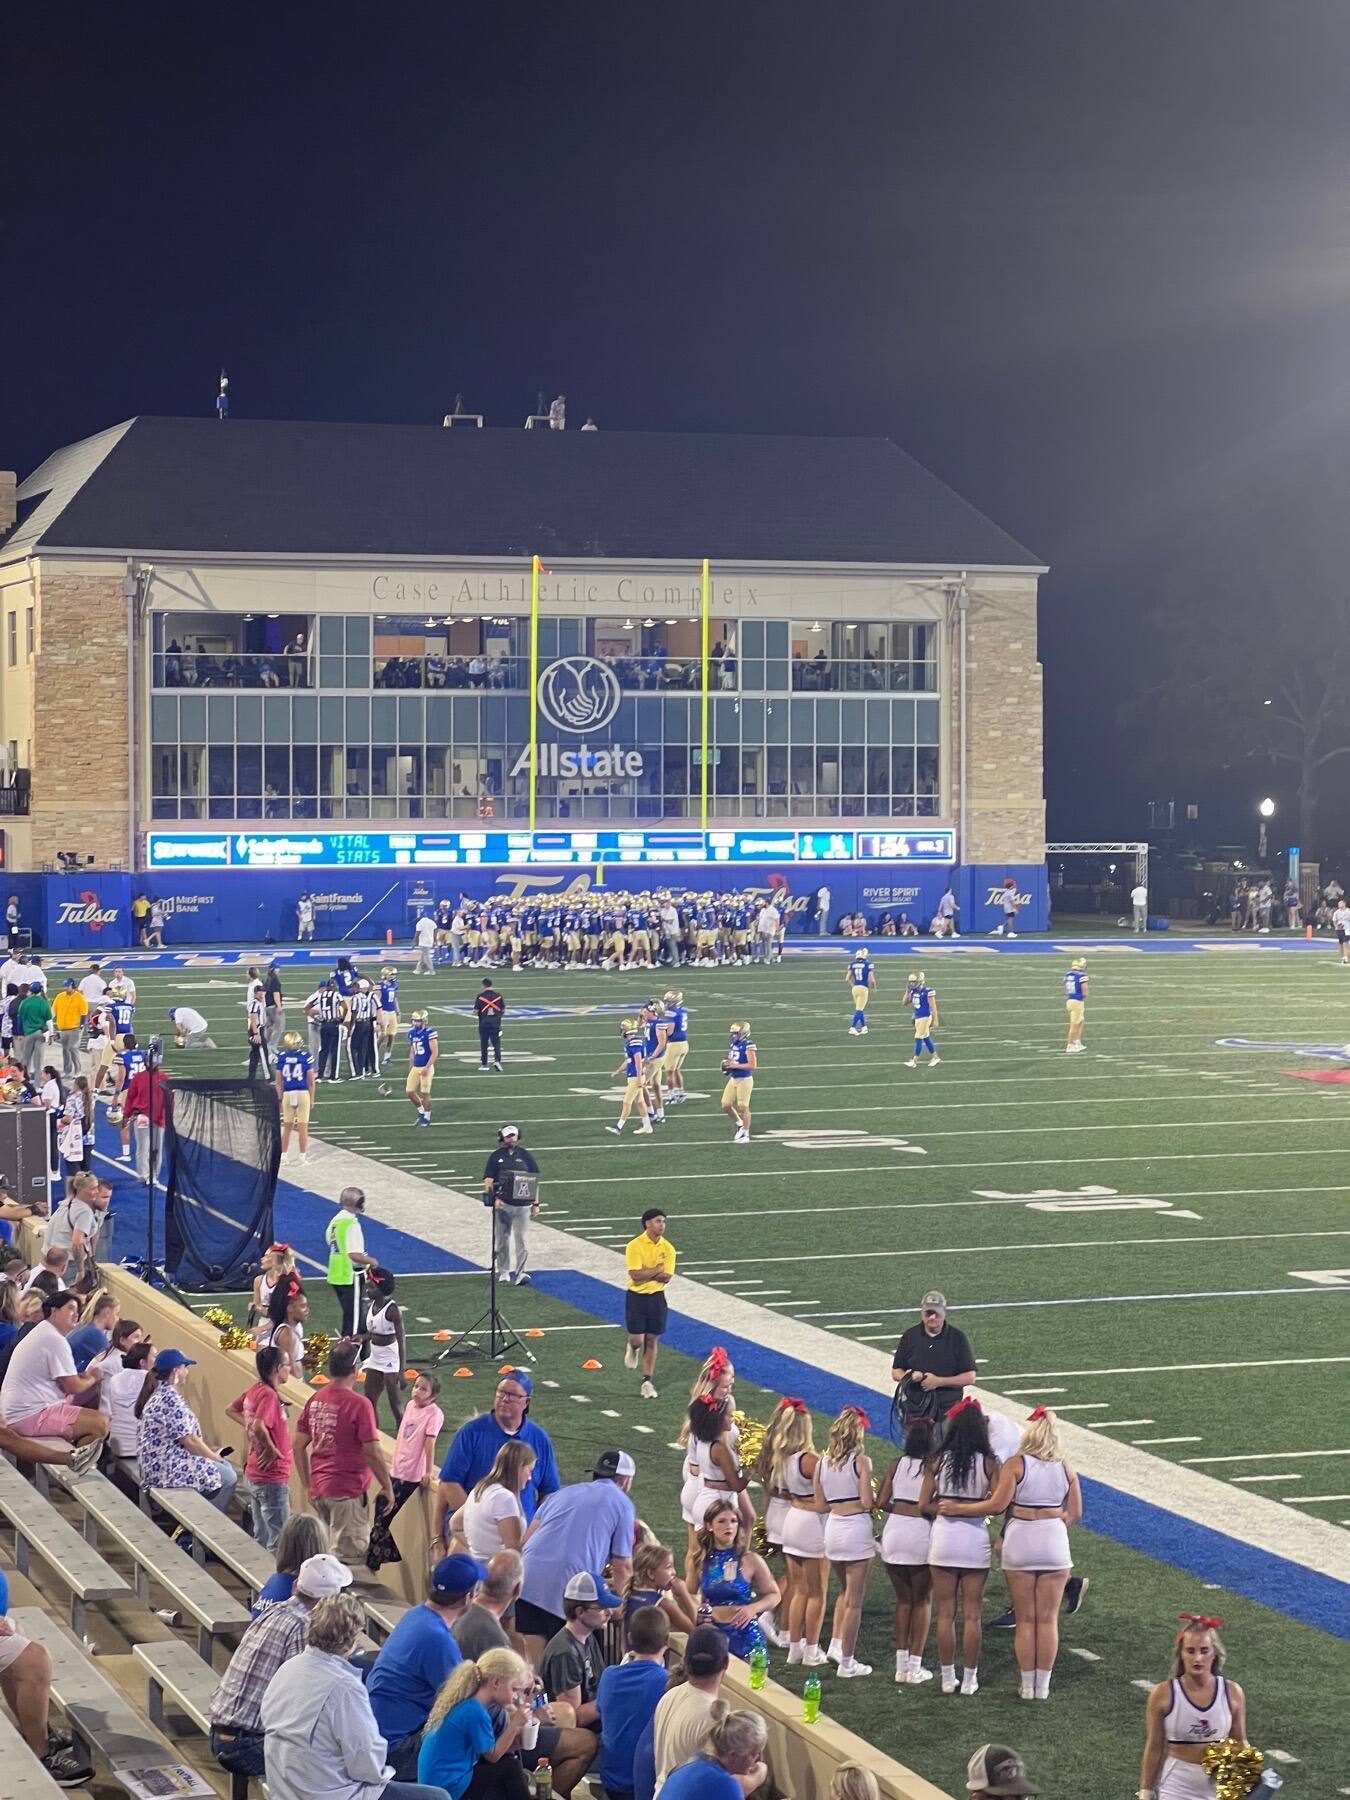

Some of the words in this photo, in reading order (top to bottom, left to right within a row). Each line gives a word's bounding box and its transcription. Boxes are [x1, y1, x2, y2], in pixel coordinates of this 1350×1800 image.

[372, 576, 439, 601] Case
[457, 578, 598, 602] Athletic
[617, 579, 758, 611] Complex
[510, 743, 644, 778] Allstate
[329, 836, 370, 849] VITAL
[336, 850, 381, 864] STATS
[310, 892, 363, 904] SaintFrancis
[743, 886, 811, 914] Tlsa
[863, 887, 891, 897] RIVER
[892, 887, 919, 897] SPIRIT
[55, 902, 119, 924] Tulsa
[175, 904, 200, 912] BANK
[117, 1007, 131, 1025] 10
[282, 1063, 304, 1082] 44
